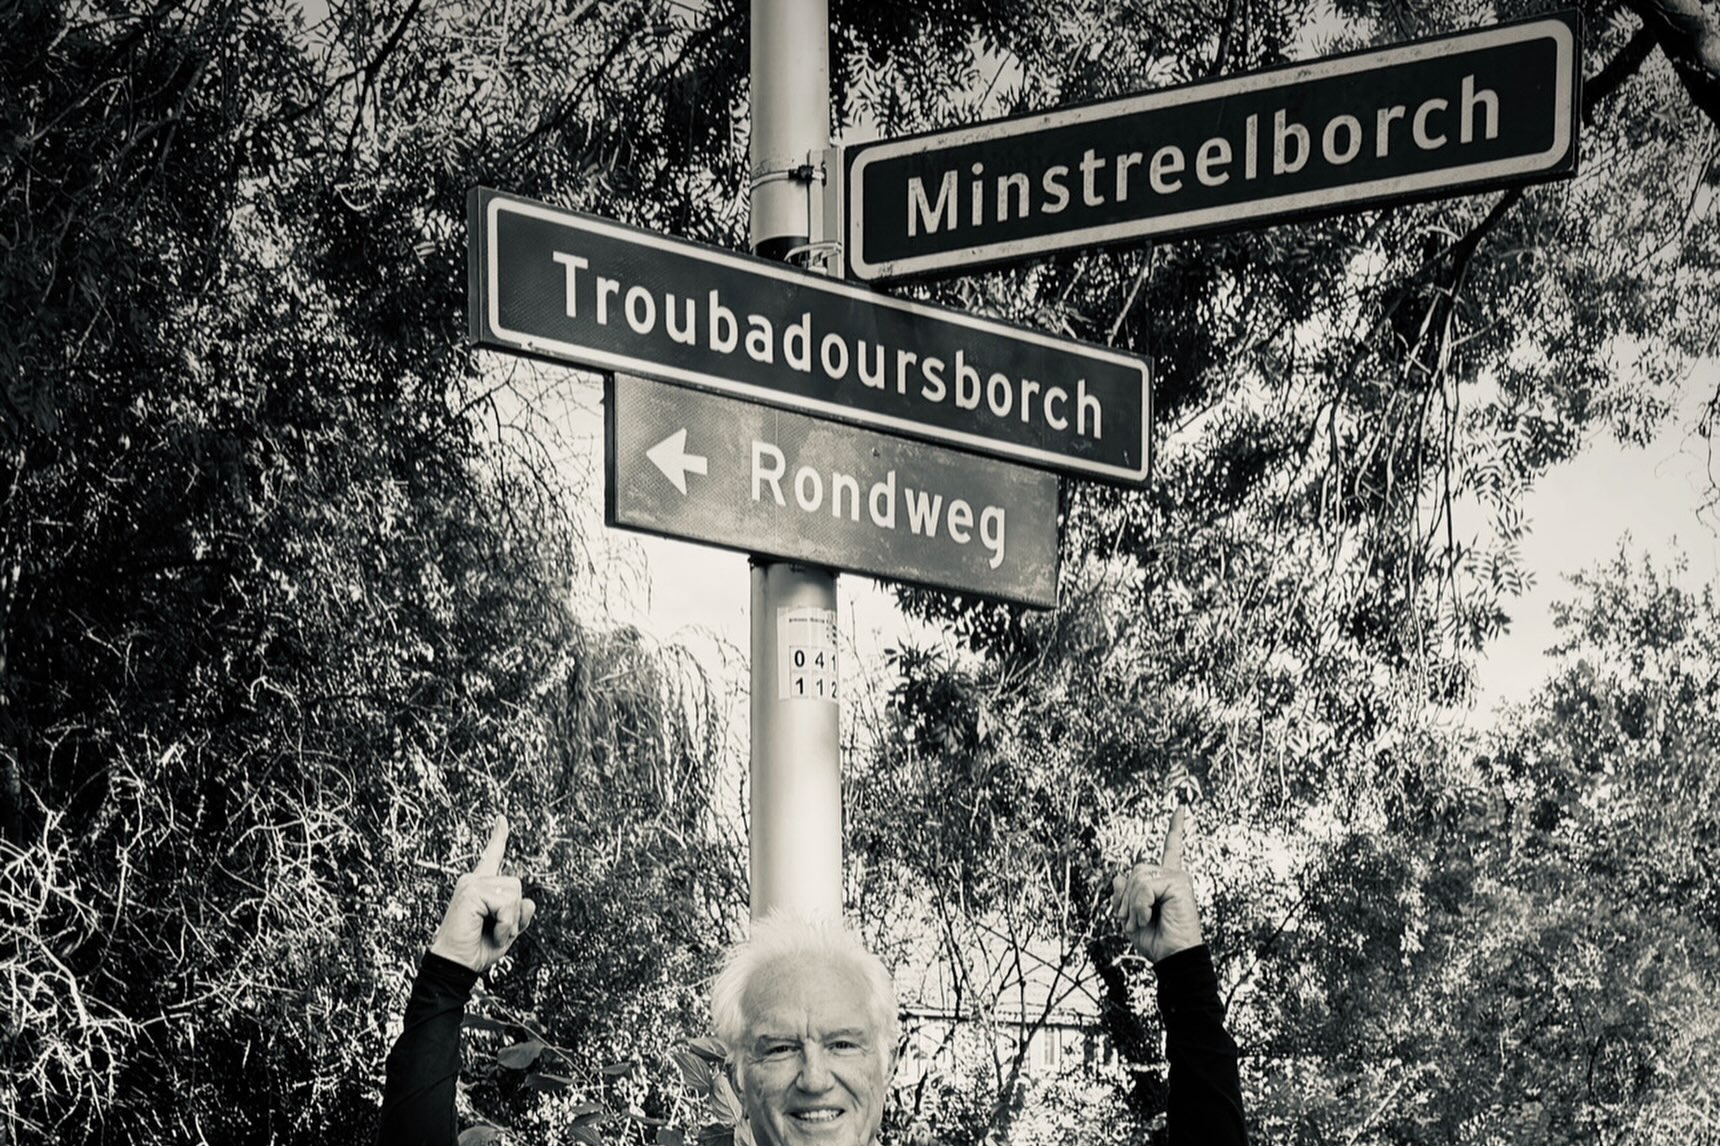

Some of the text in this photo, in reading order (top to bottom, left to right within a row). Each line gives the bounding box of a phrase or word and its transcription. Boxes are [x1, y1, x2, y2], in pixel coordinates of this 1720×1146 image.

[906, 74, 1500, 238] Minstreelborch
[552, 250, 1103, 440] Troubadoursborch
[750, 439, 1008, 570] Rondweg
